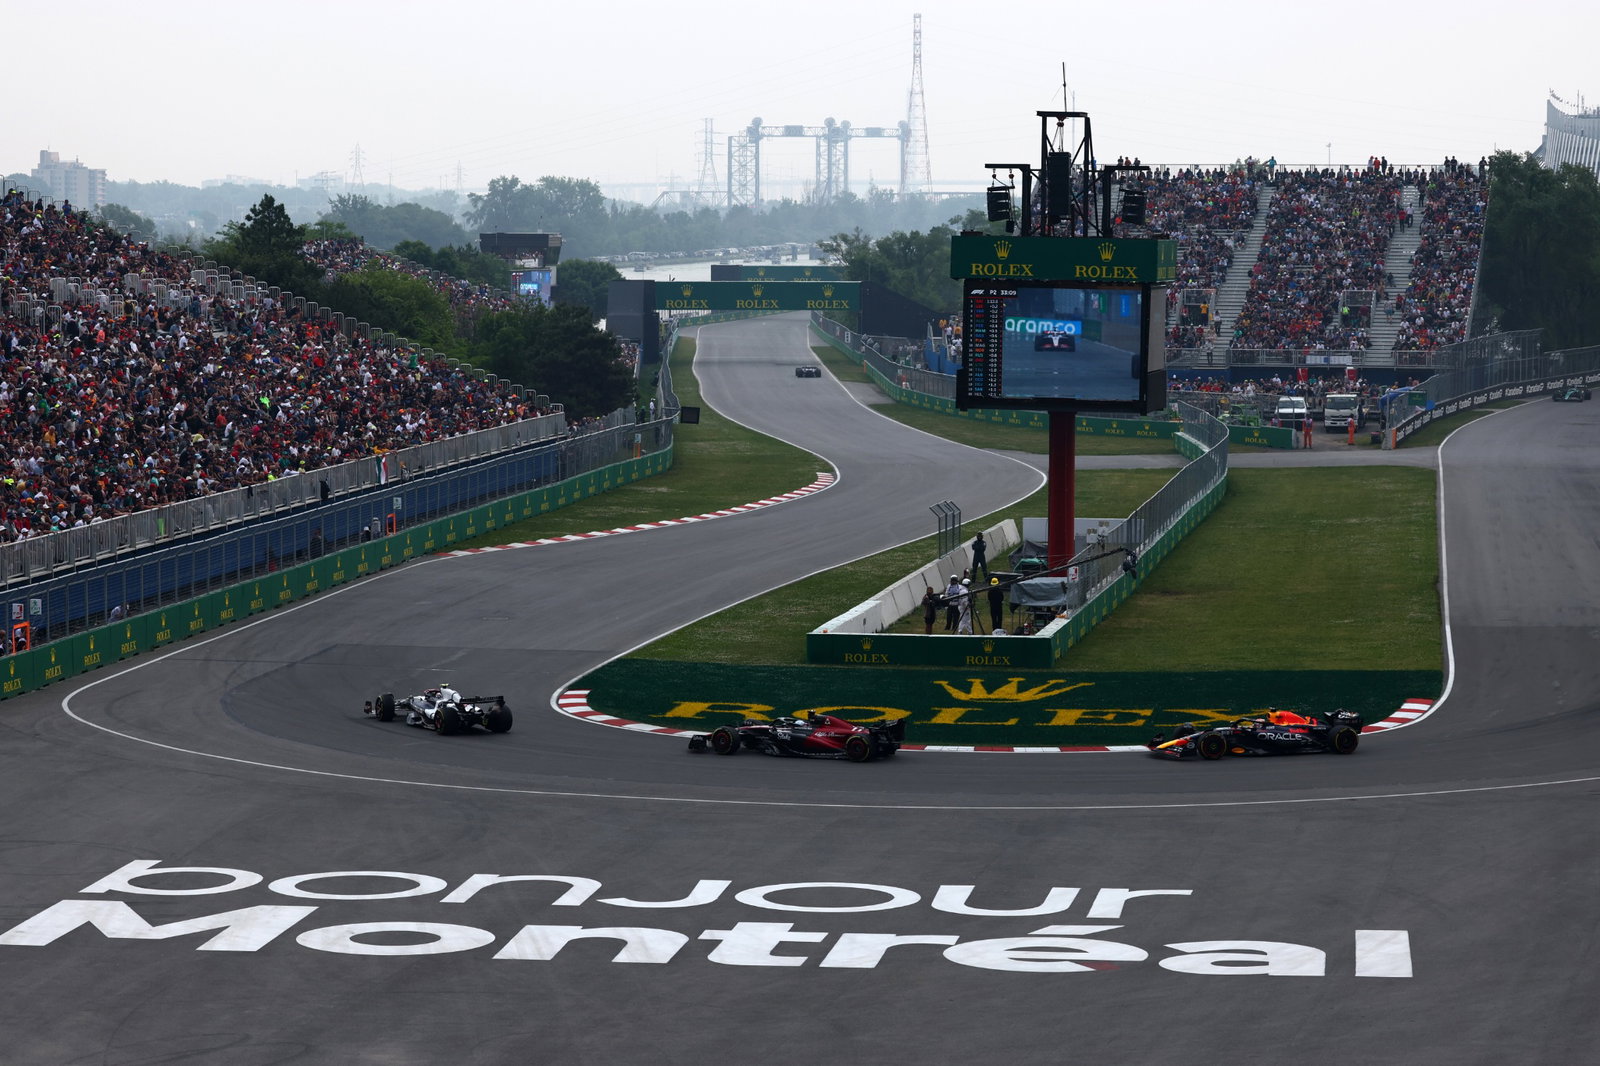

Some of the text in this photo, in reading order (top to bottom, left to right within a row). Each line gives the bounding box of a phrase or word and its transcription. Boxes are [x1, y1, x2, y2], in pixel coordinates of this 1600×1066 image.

[971, 263, 1034, 277] ROLEX
[1075, 265, 1138, 279] ROLEX
[665, 300, 709, 309] ROLEX
[736, 300, 779, 309] ROLEX
[807, 300, 849, 309] ROLEX
[1005, 318, 1076, 334] aramco
[190, 618, 204, 631] ROLEX
[156, 629, 171, 641] ROLEX
[121, 640, 137, 654] ROLEX
[84, 652, 101, 666] ROLEX
[844, 653, 889, 664] ROLEX
[966, 656, 1010, 666] ROLEX
[45, 665, 63, 680] ROLEX
[3, 678, 22, 693] ROLEX
[649, 701, 1296, 727] ROLEX
[1257, 732, 1302, 741] ORACLE
[78, 859, 1194, 919] bonjour
[0, 899, 1413, 977] Montréal
